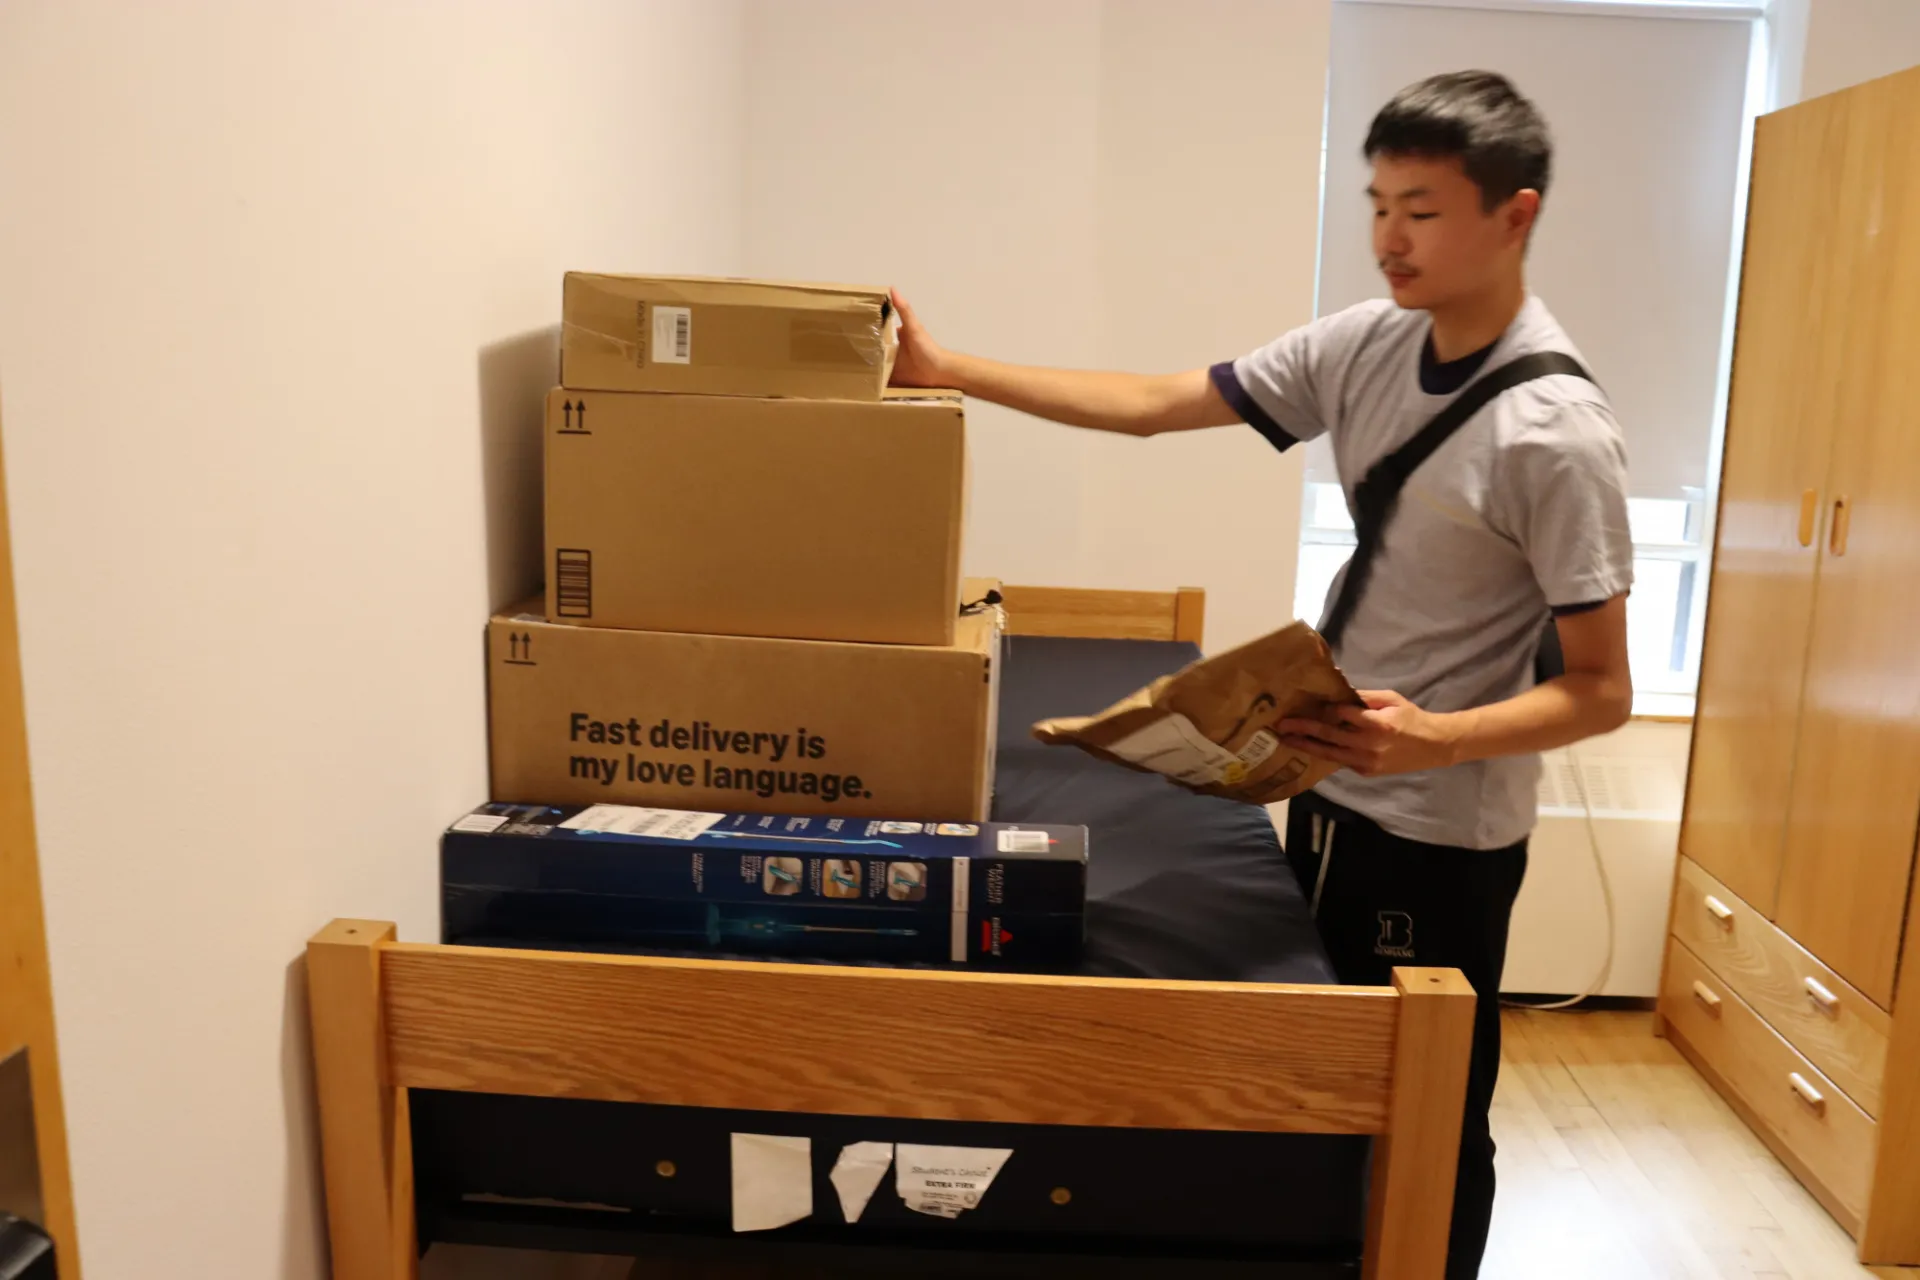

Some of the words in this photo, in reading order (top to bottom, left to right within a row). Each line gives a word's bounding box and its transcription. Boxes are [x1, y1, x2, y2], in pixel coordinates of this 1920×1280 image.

[569, 712, 642, 746] Fast
[649, 719, 790, 762] delivery
[797, 727, 826, 760] is
[569, 755, 619, 786] my
[627, 753, 696, 785] love
[703, 759, 873, 803] language.
[994, 863, 1005, 904] FEATHER
[926, 1180, 953, 1188] EXTRA
[954, 1181, 977, 1189] FIRM
